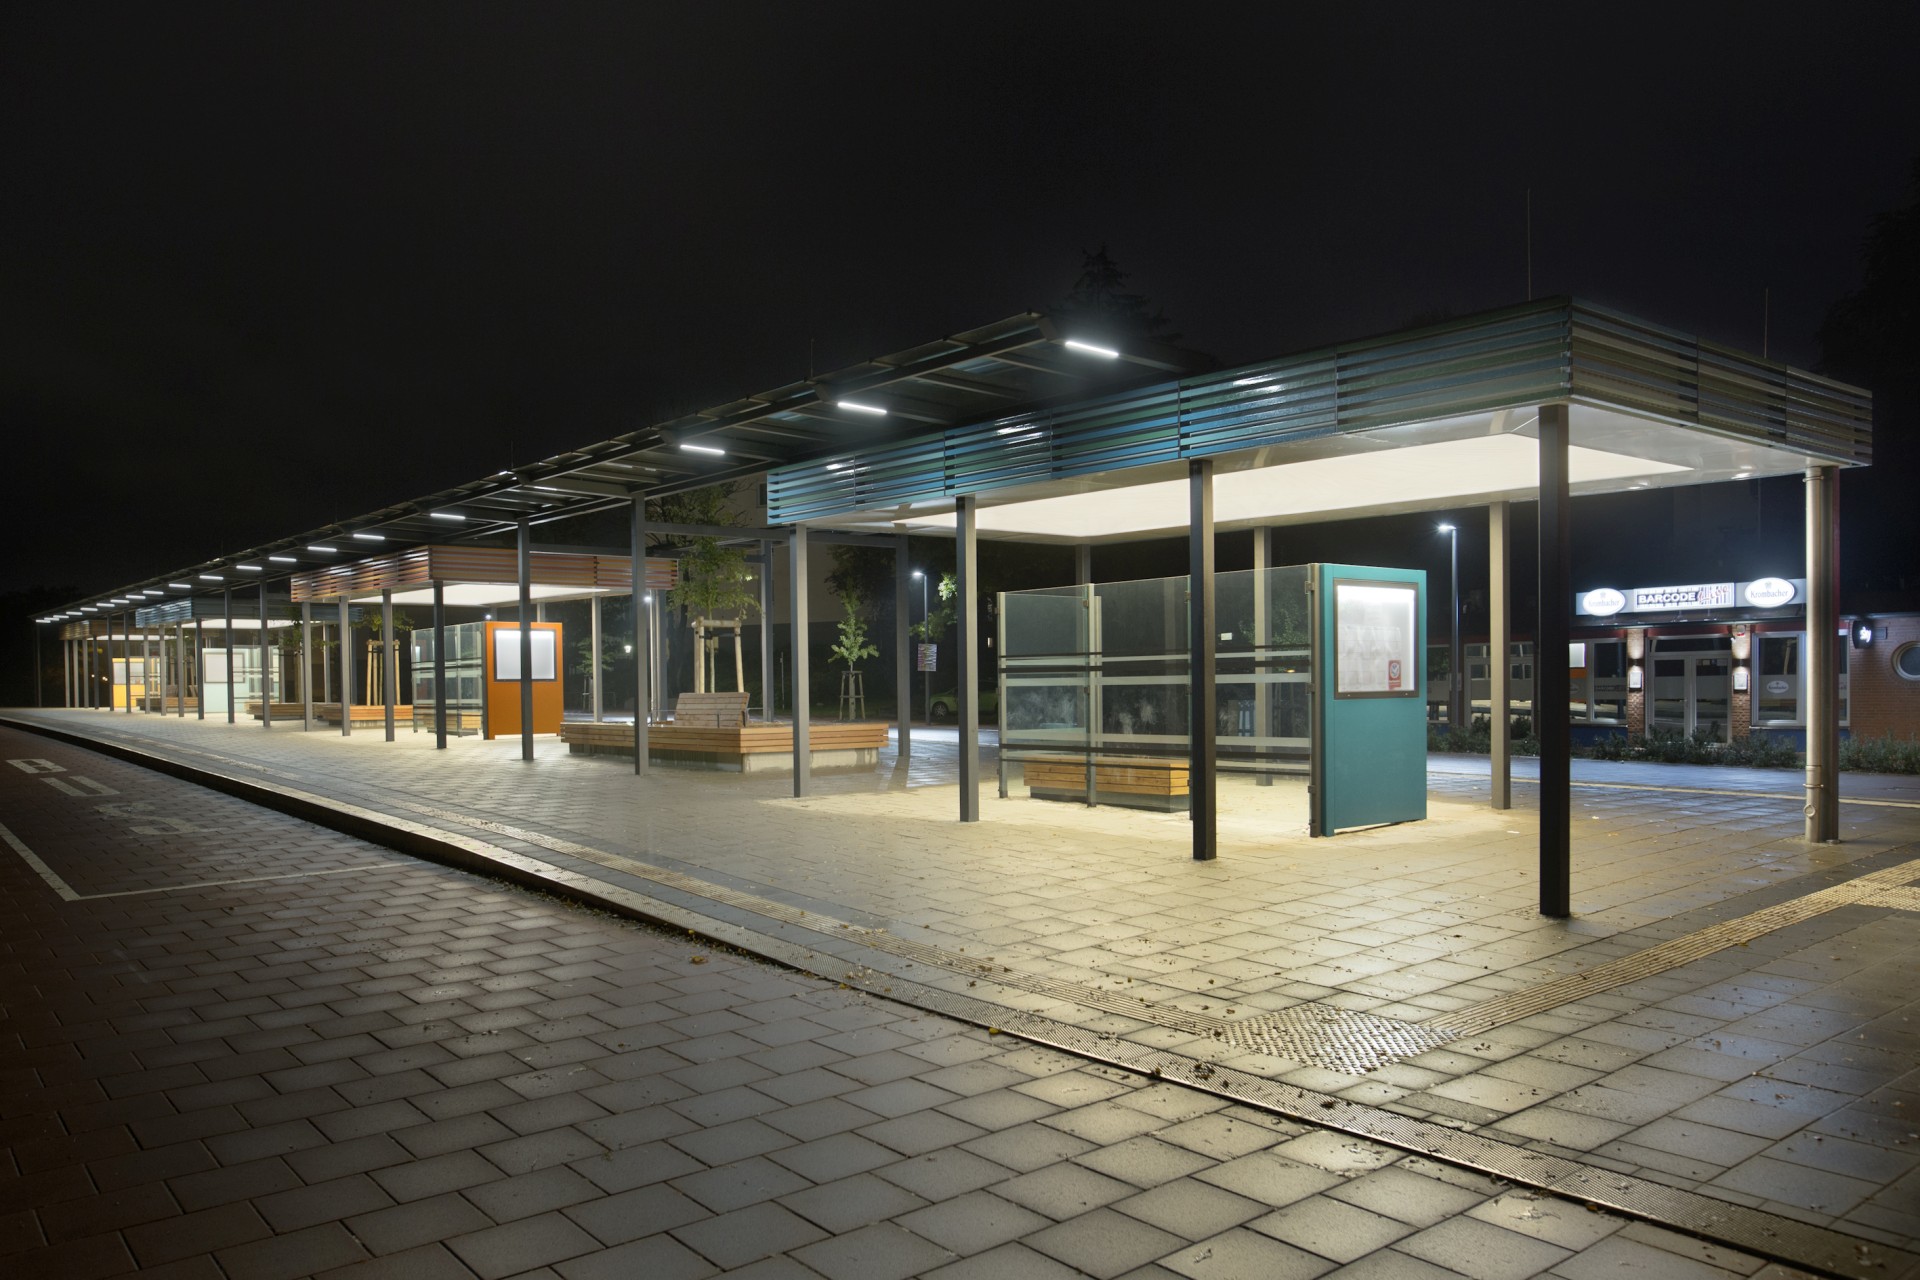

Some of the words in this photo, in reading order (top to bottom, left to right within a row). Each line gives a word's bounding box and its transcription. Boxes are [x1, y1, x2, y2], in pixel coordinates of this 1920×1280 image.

[1638, 592, 1695, 604] BARCODE
[1750, 588, 1789, 599] Krombacher
[6, 759, 200, 835] BUS
